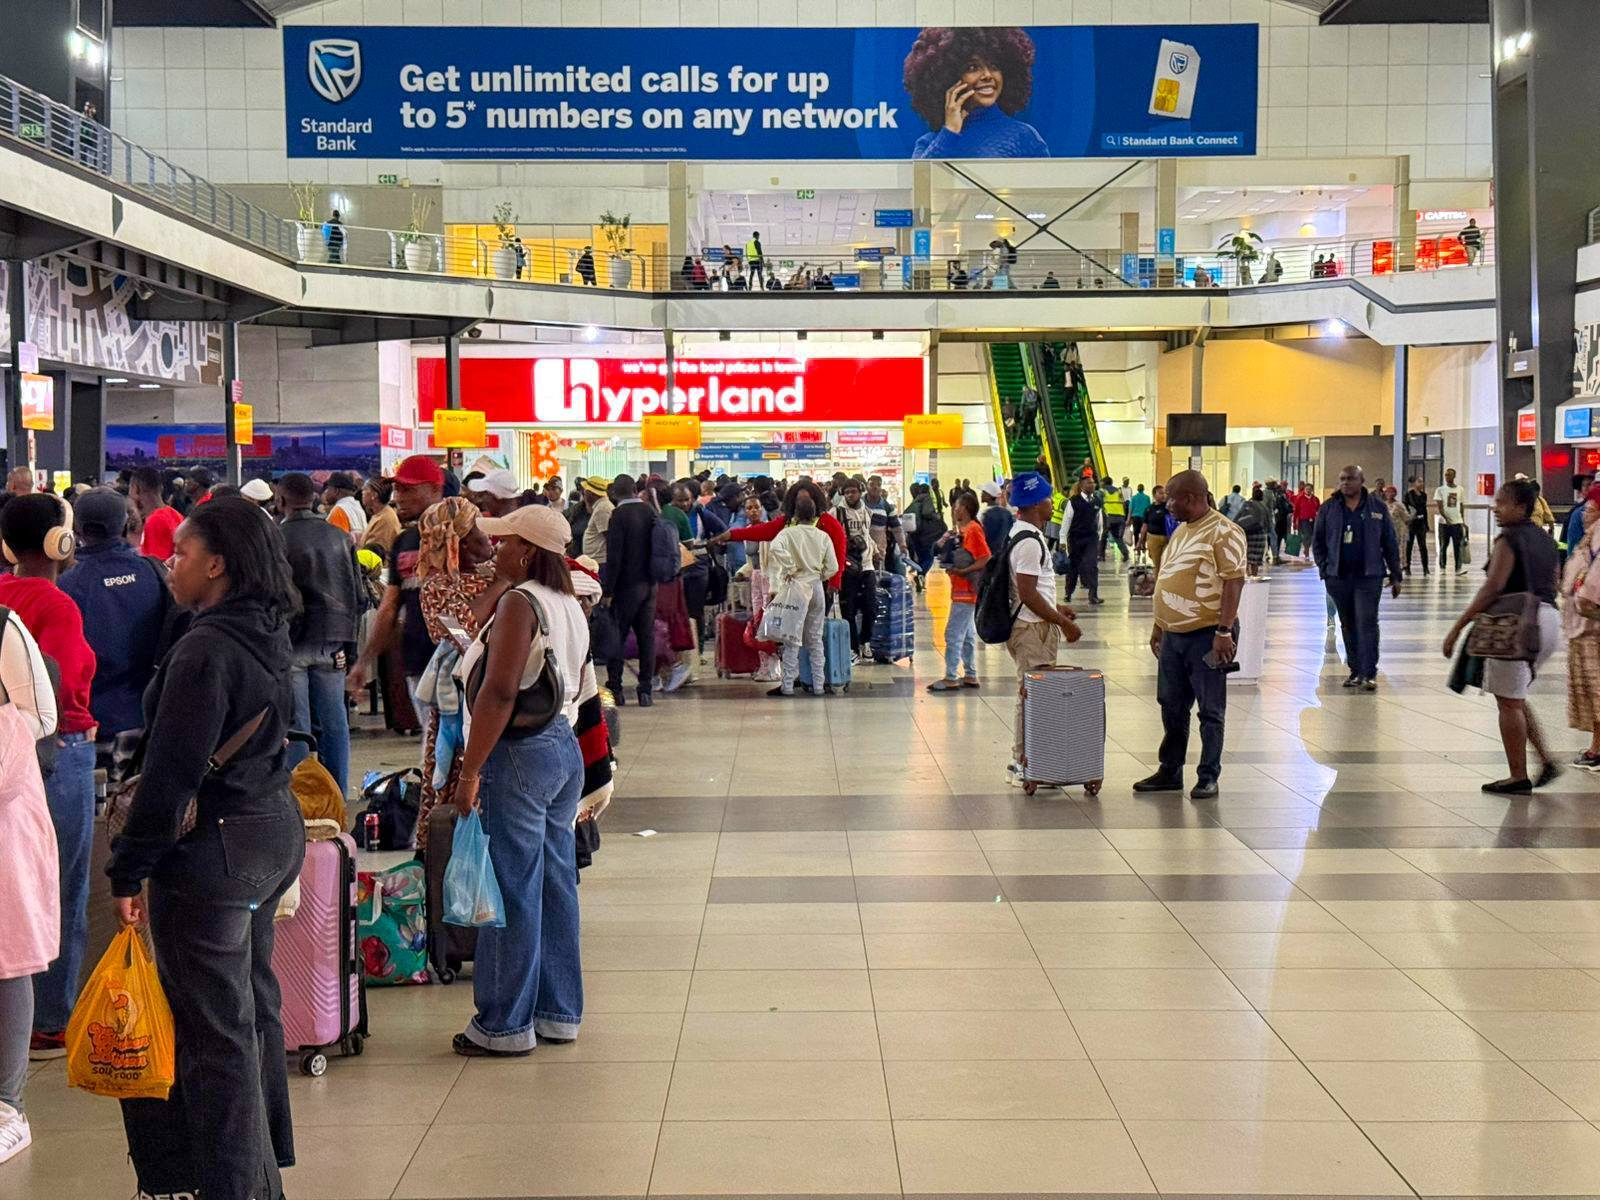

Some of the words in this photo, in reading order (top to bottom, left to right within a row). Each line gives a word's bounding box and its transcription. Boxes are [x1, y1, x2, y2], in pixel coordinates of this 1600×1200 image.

[400, 64, 460, 93] Get
[470, 64, 631, 93] unlimited
[641, 65, 718, 93] calls
[727, 65, 778, 93] for
[787, 72, 830, 99] up
[301, 117, 372, 135] Standard
[400, 101, 436, 129] to
[486, 101, 633, 129] numbers
[642, 108, 683, 129] on
[692, 108, 753, 135] any
[762, 101, 898, 129] network
[317, 135, 356, 151] Bank
[1122, 136, 1167, 146] Standard
[1169, 136, 1194, 145] Bank
[1196, 135, 1238, 145] Connect
[658, 362, 679, 377] gt
[534, 358, 804, 421] hyperland
[104, 574, 136, 587] EPSON
[114, 1072, 139, 1080] FOOD
